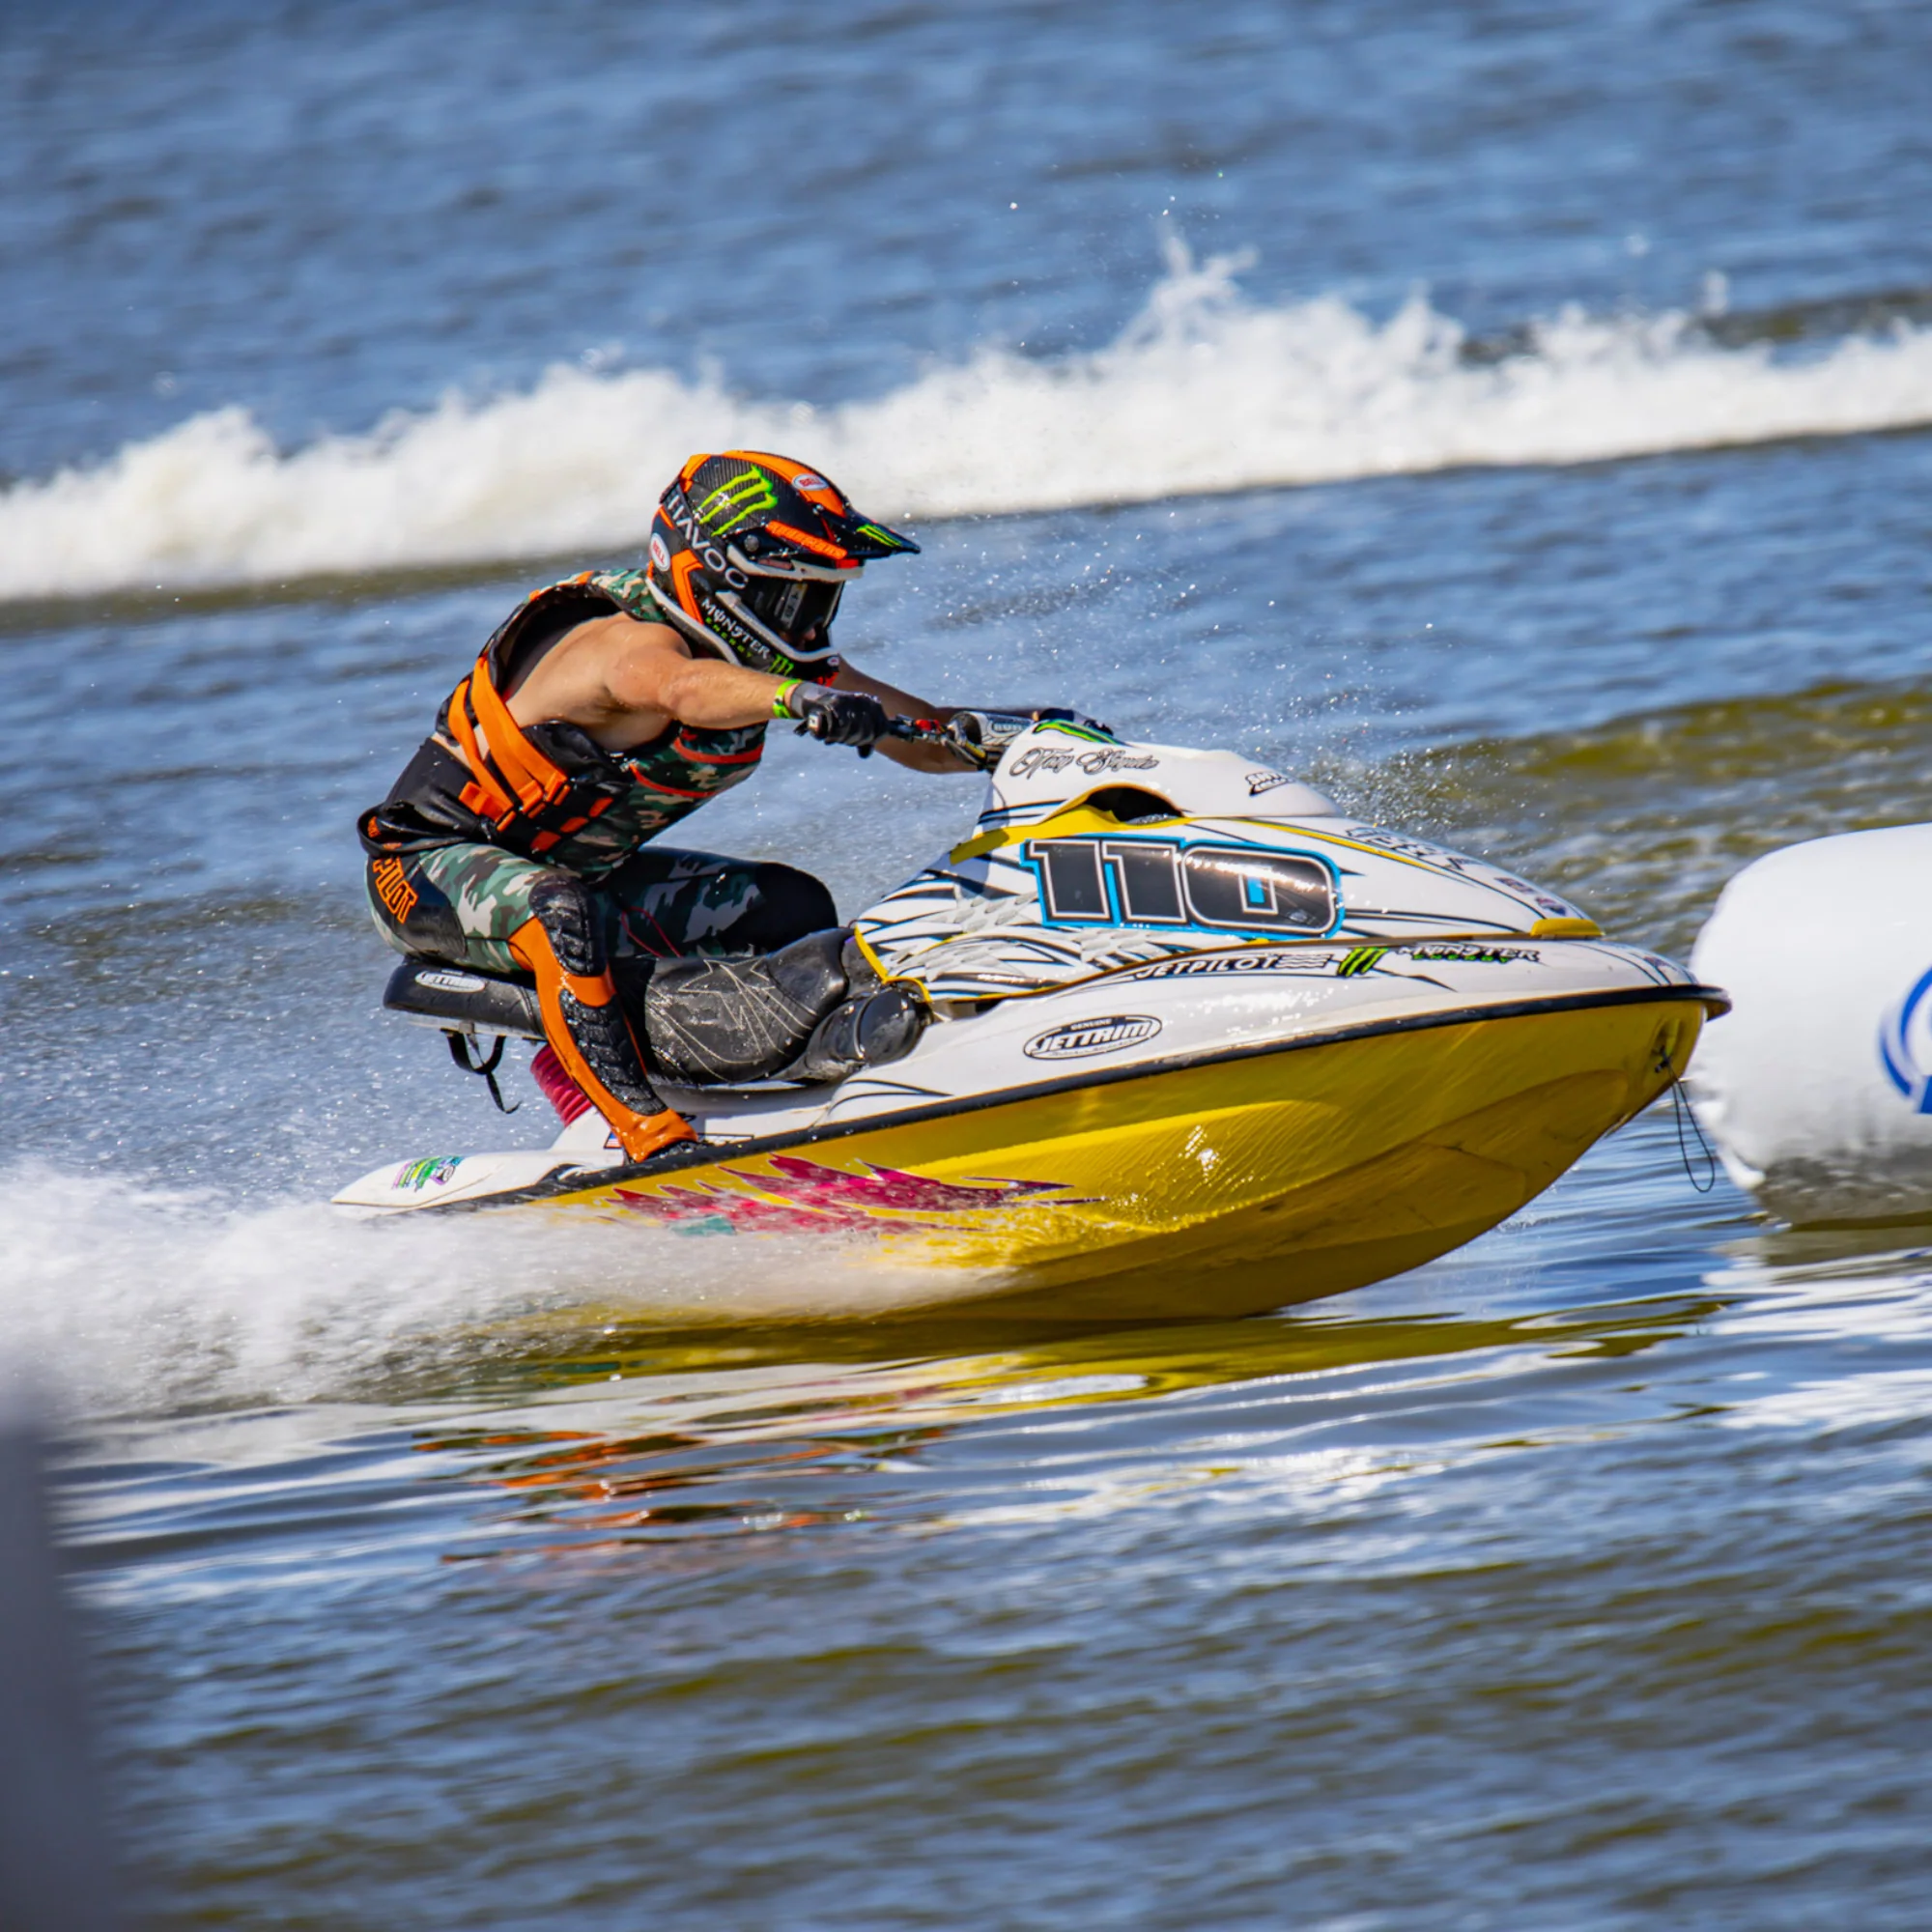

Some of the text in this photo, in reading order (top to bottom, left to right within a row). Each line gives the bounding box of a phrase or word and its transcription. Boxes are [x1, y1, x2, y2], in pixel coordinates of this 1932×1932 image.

[701, 597, 772, 660] MONSTER
[1022, 835, 1343, 938] 110
[1135, 952, 1280, 980] JETPILOT
[1396, 944, 1541, 962] MONSTER
[1031, 1020, 1153, 1055] JETTRIM
